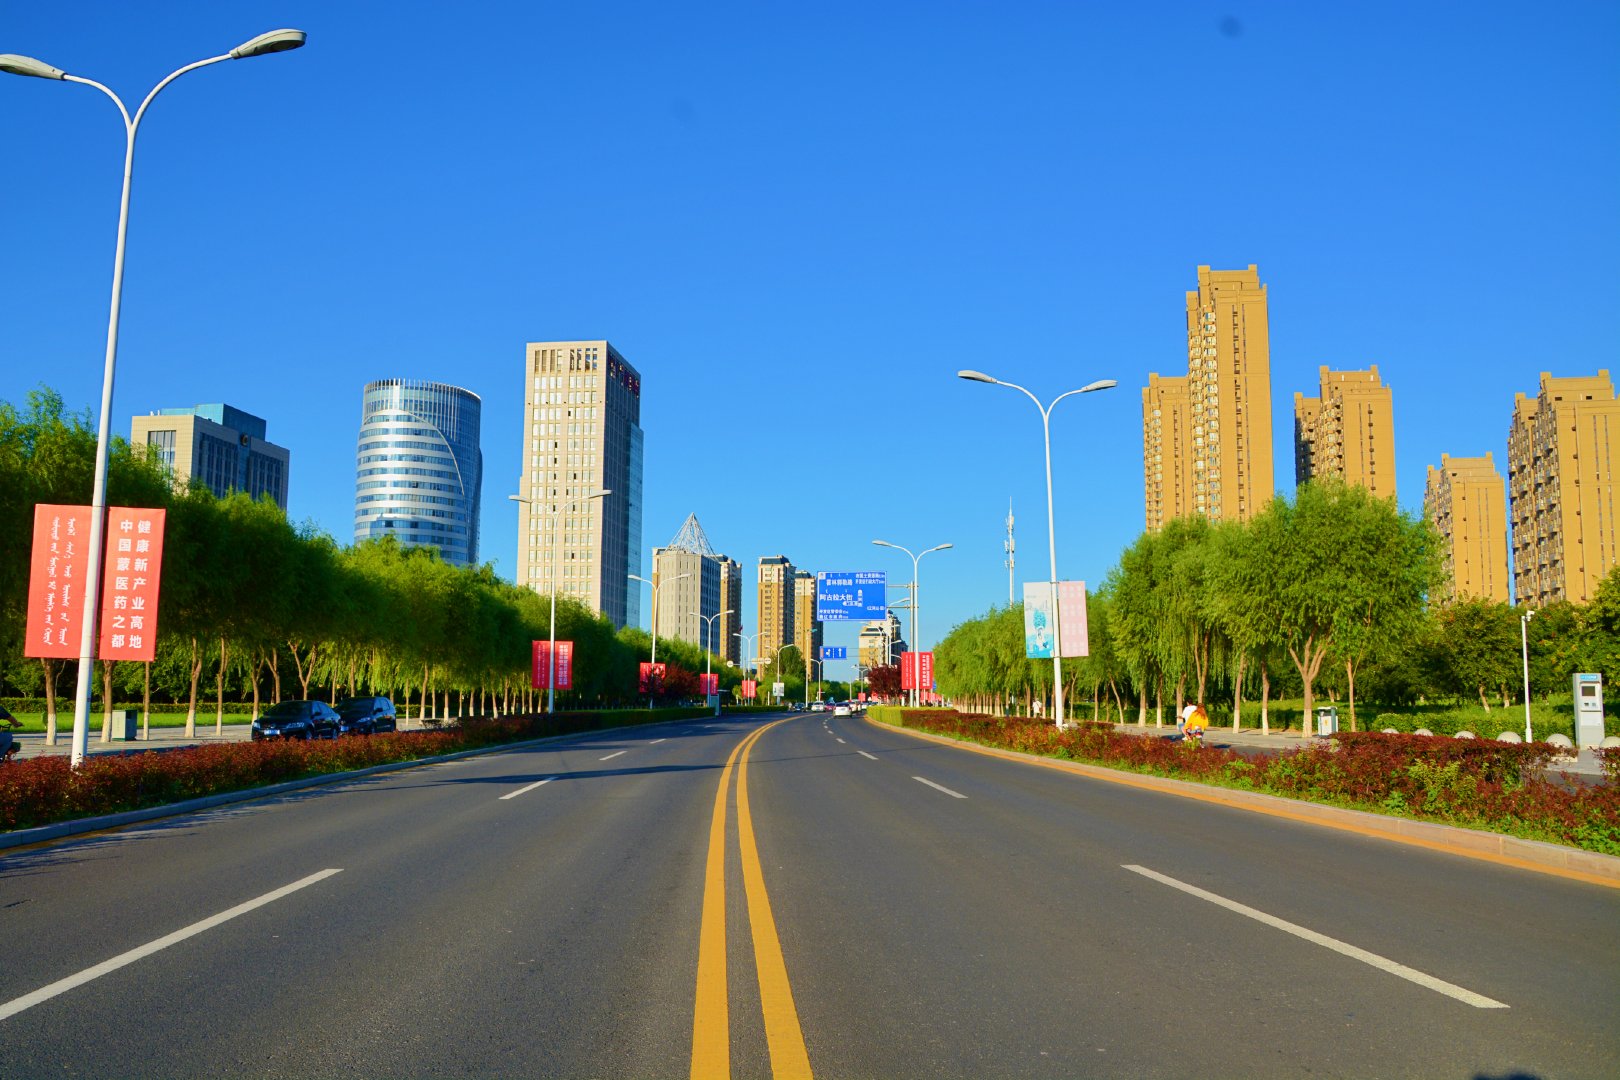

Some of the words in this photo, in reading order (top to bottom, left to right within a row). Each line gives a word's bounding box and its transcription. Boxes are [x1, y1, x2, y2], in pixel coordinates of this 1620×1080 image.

[111, 519, 133, 649] 中国蒙医药之都
[128, 519, 152, 649] 健康新产业高地
